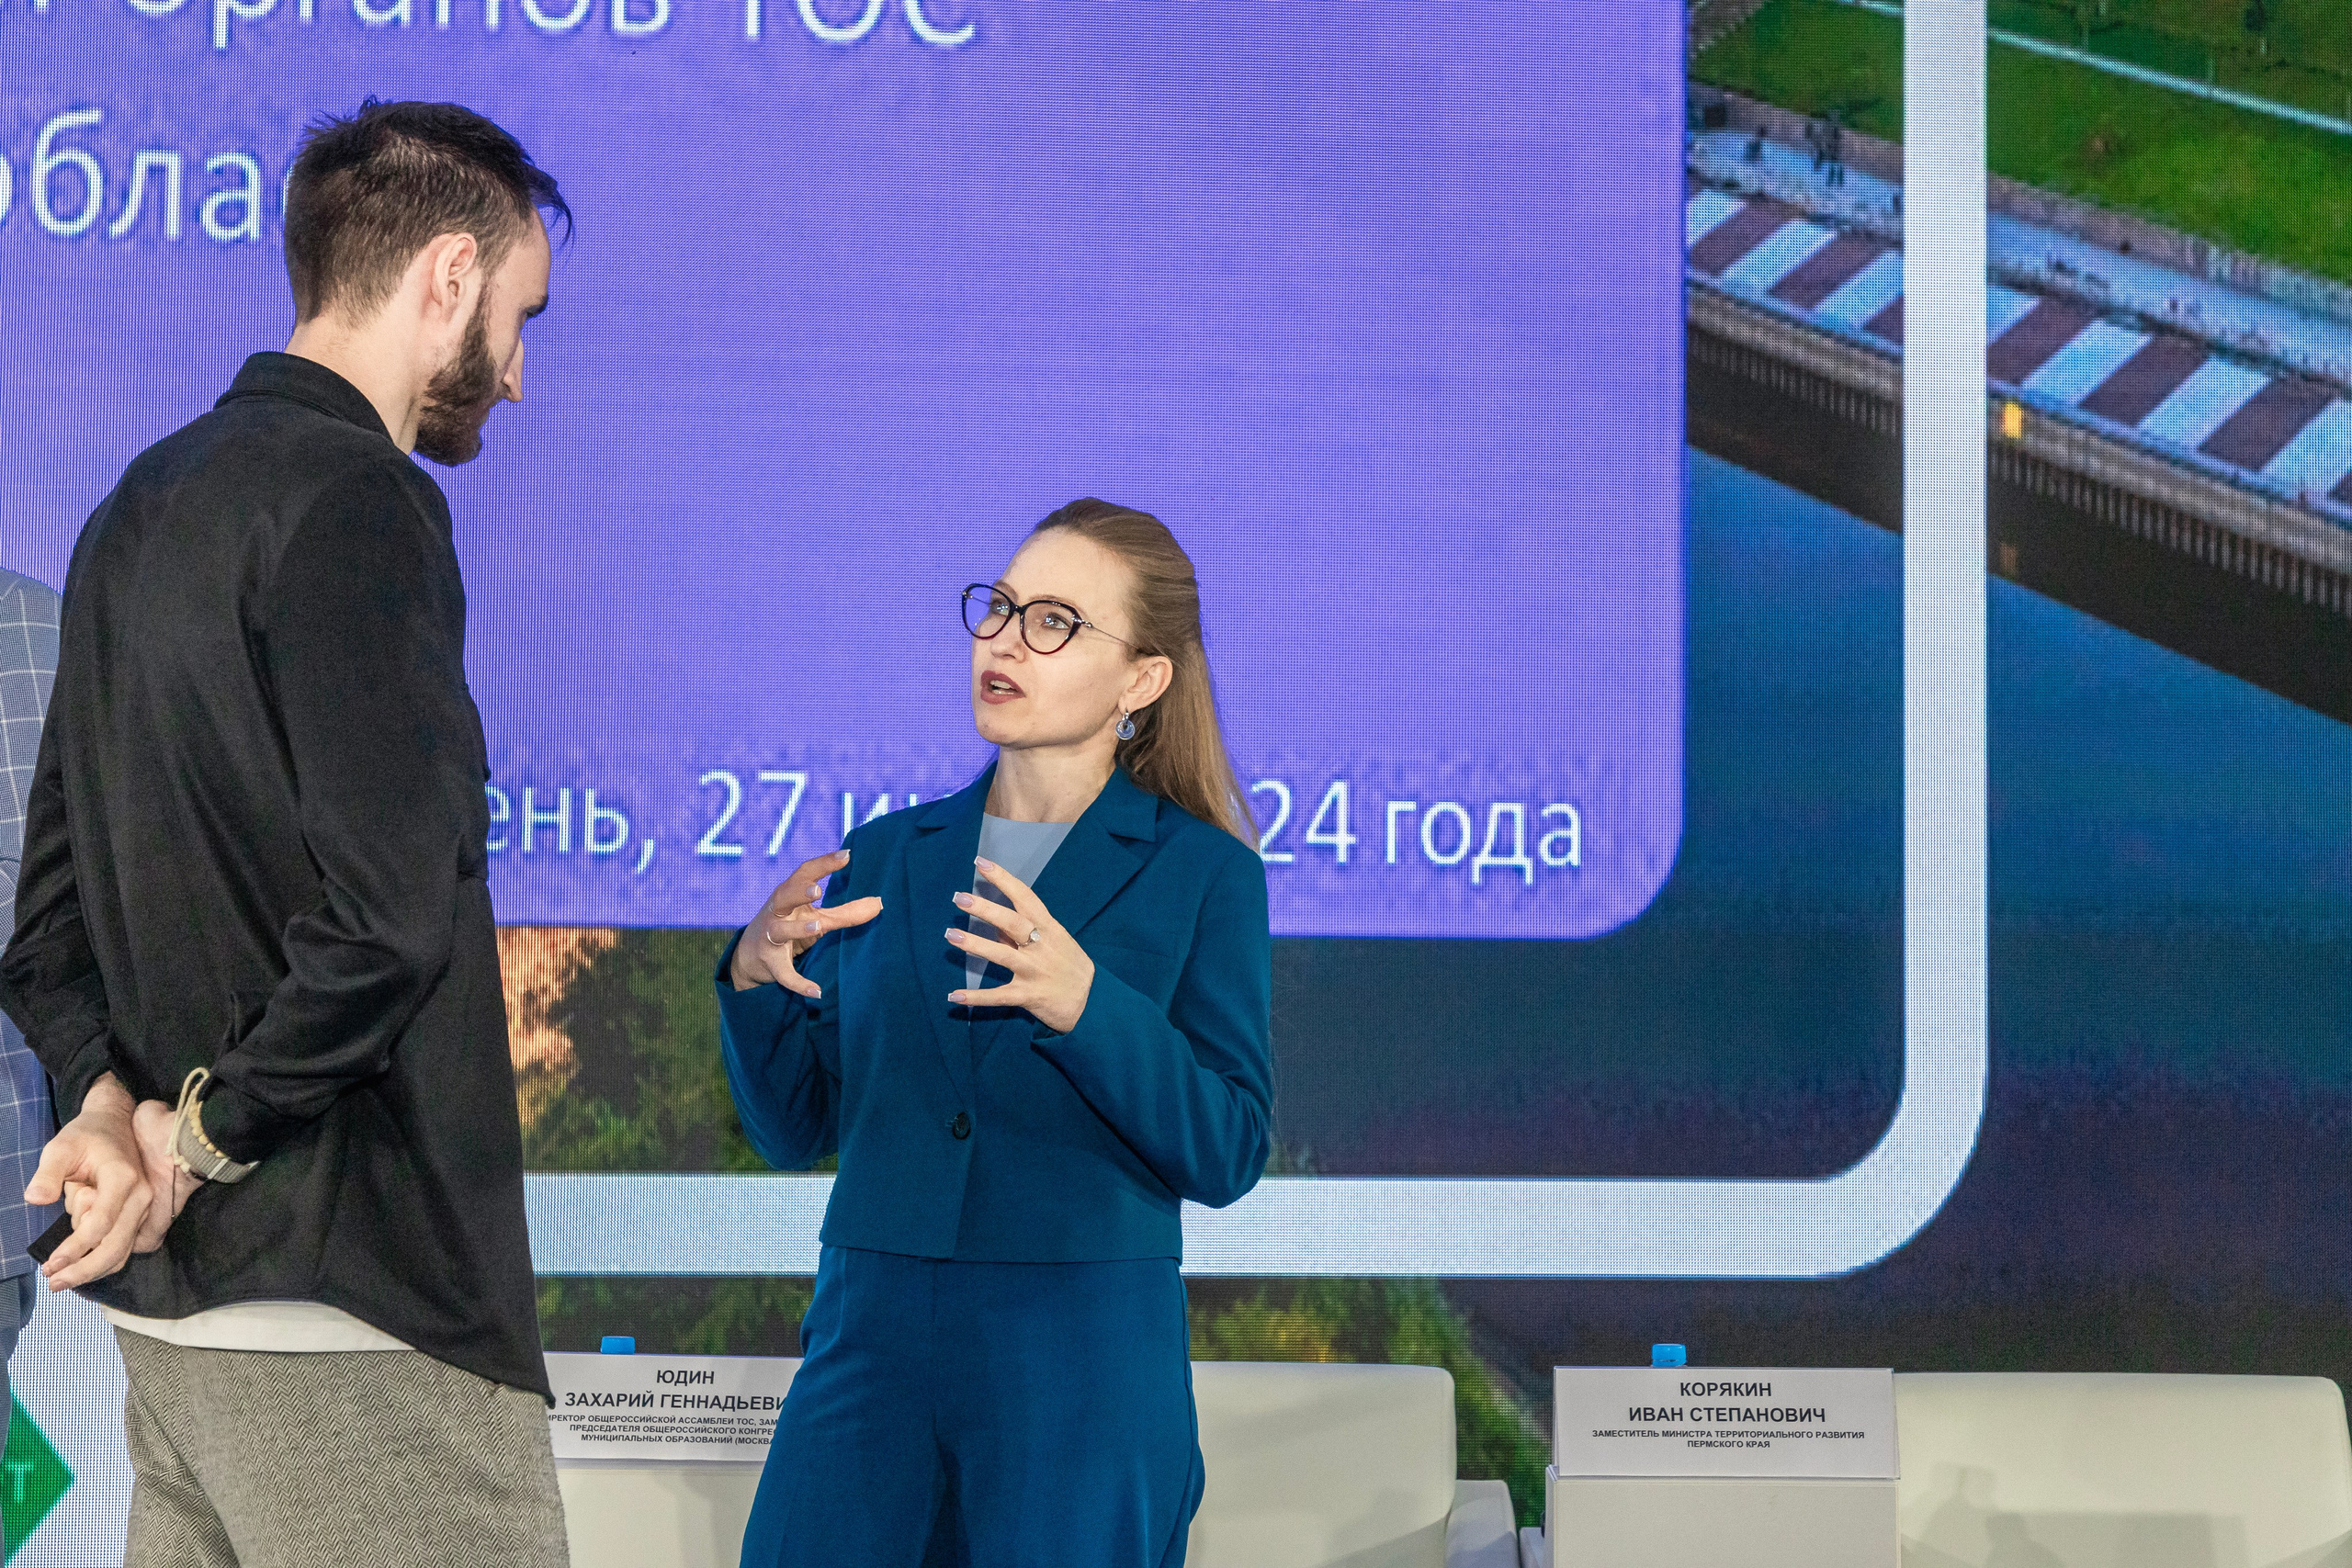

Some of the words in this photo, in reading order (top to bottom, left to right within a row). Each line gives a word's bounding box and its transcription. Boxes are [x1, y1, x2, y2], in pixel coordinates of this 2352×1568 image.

[0, 108, 292, 242] бла
[696, 770, 807, 856] 27
[1386, 800, 1581, 885] года
[656, 1370, 715, 1386] ЮДИН
[1680, 1382, 1772, 1397] КОРЯКИН
[564, 1390, 654, 1407] ЗАХАРИЙ
[588, 1415, 676, 1424] ОБЩЕРОССИЙСКОЙ
[678, 1416, 734, 1426] АССАМБЛЕИ
[737, 1417, 756, 1427] ТОС,
[1629, 1407, 1683, 1422] ИВАН
[1690, 1407, 1826, 1423] СТЕПАНОВИЧ
[570, 1425, 640, 1433] ПРЕДСЕДАТЕЛЯ
[643, 1425, 736, 1435] ОБЩЕРОССИЙСКОГО
[1592, 1429, 1659, 1438] ЗАМЕСТИТЕЛЬ
[1662, 1430, 1713, 1438] МИНИСТРА
[1715, 1430, 1814, 1439] ТЕРРИТОРИАЛЬНОГО
[1815, 1431, 1865, 1439] РАЗВИТИЯ
[581, 1434, 662, 1443] МУНИЦИПАЛЬНЫХ
[665, 1435, 733, 1444] ОБРАЗОВАНИЙ
[1687, 1440, 1744, 1449] ПЕРМСКОГО
[1746, 1440, 1770, 1449] КРАЯ
